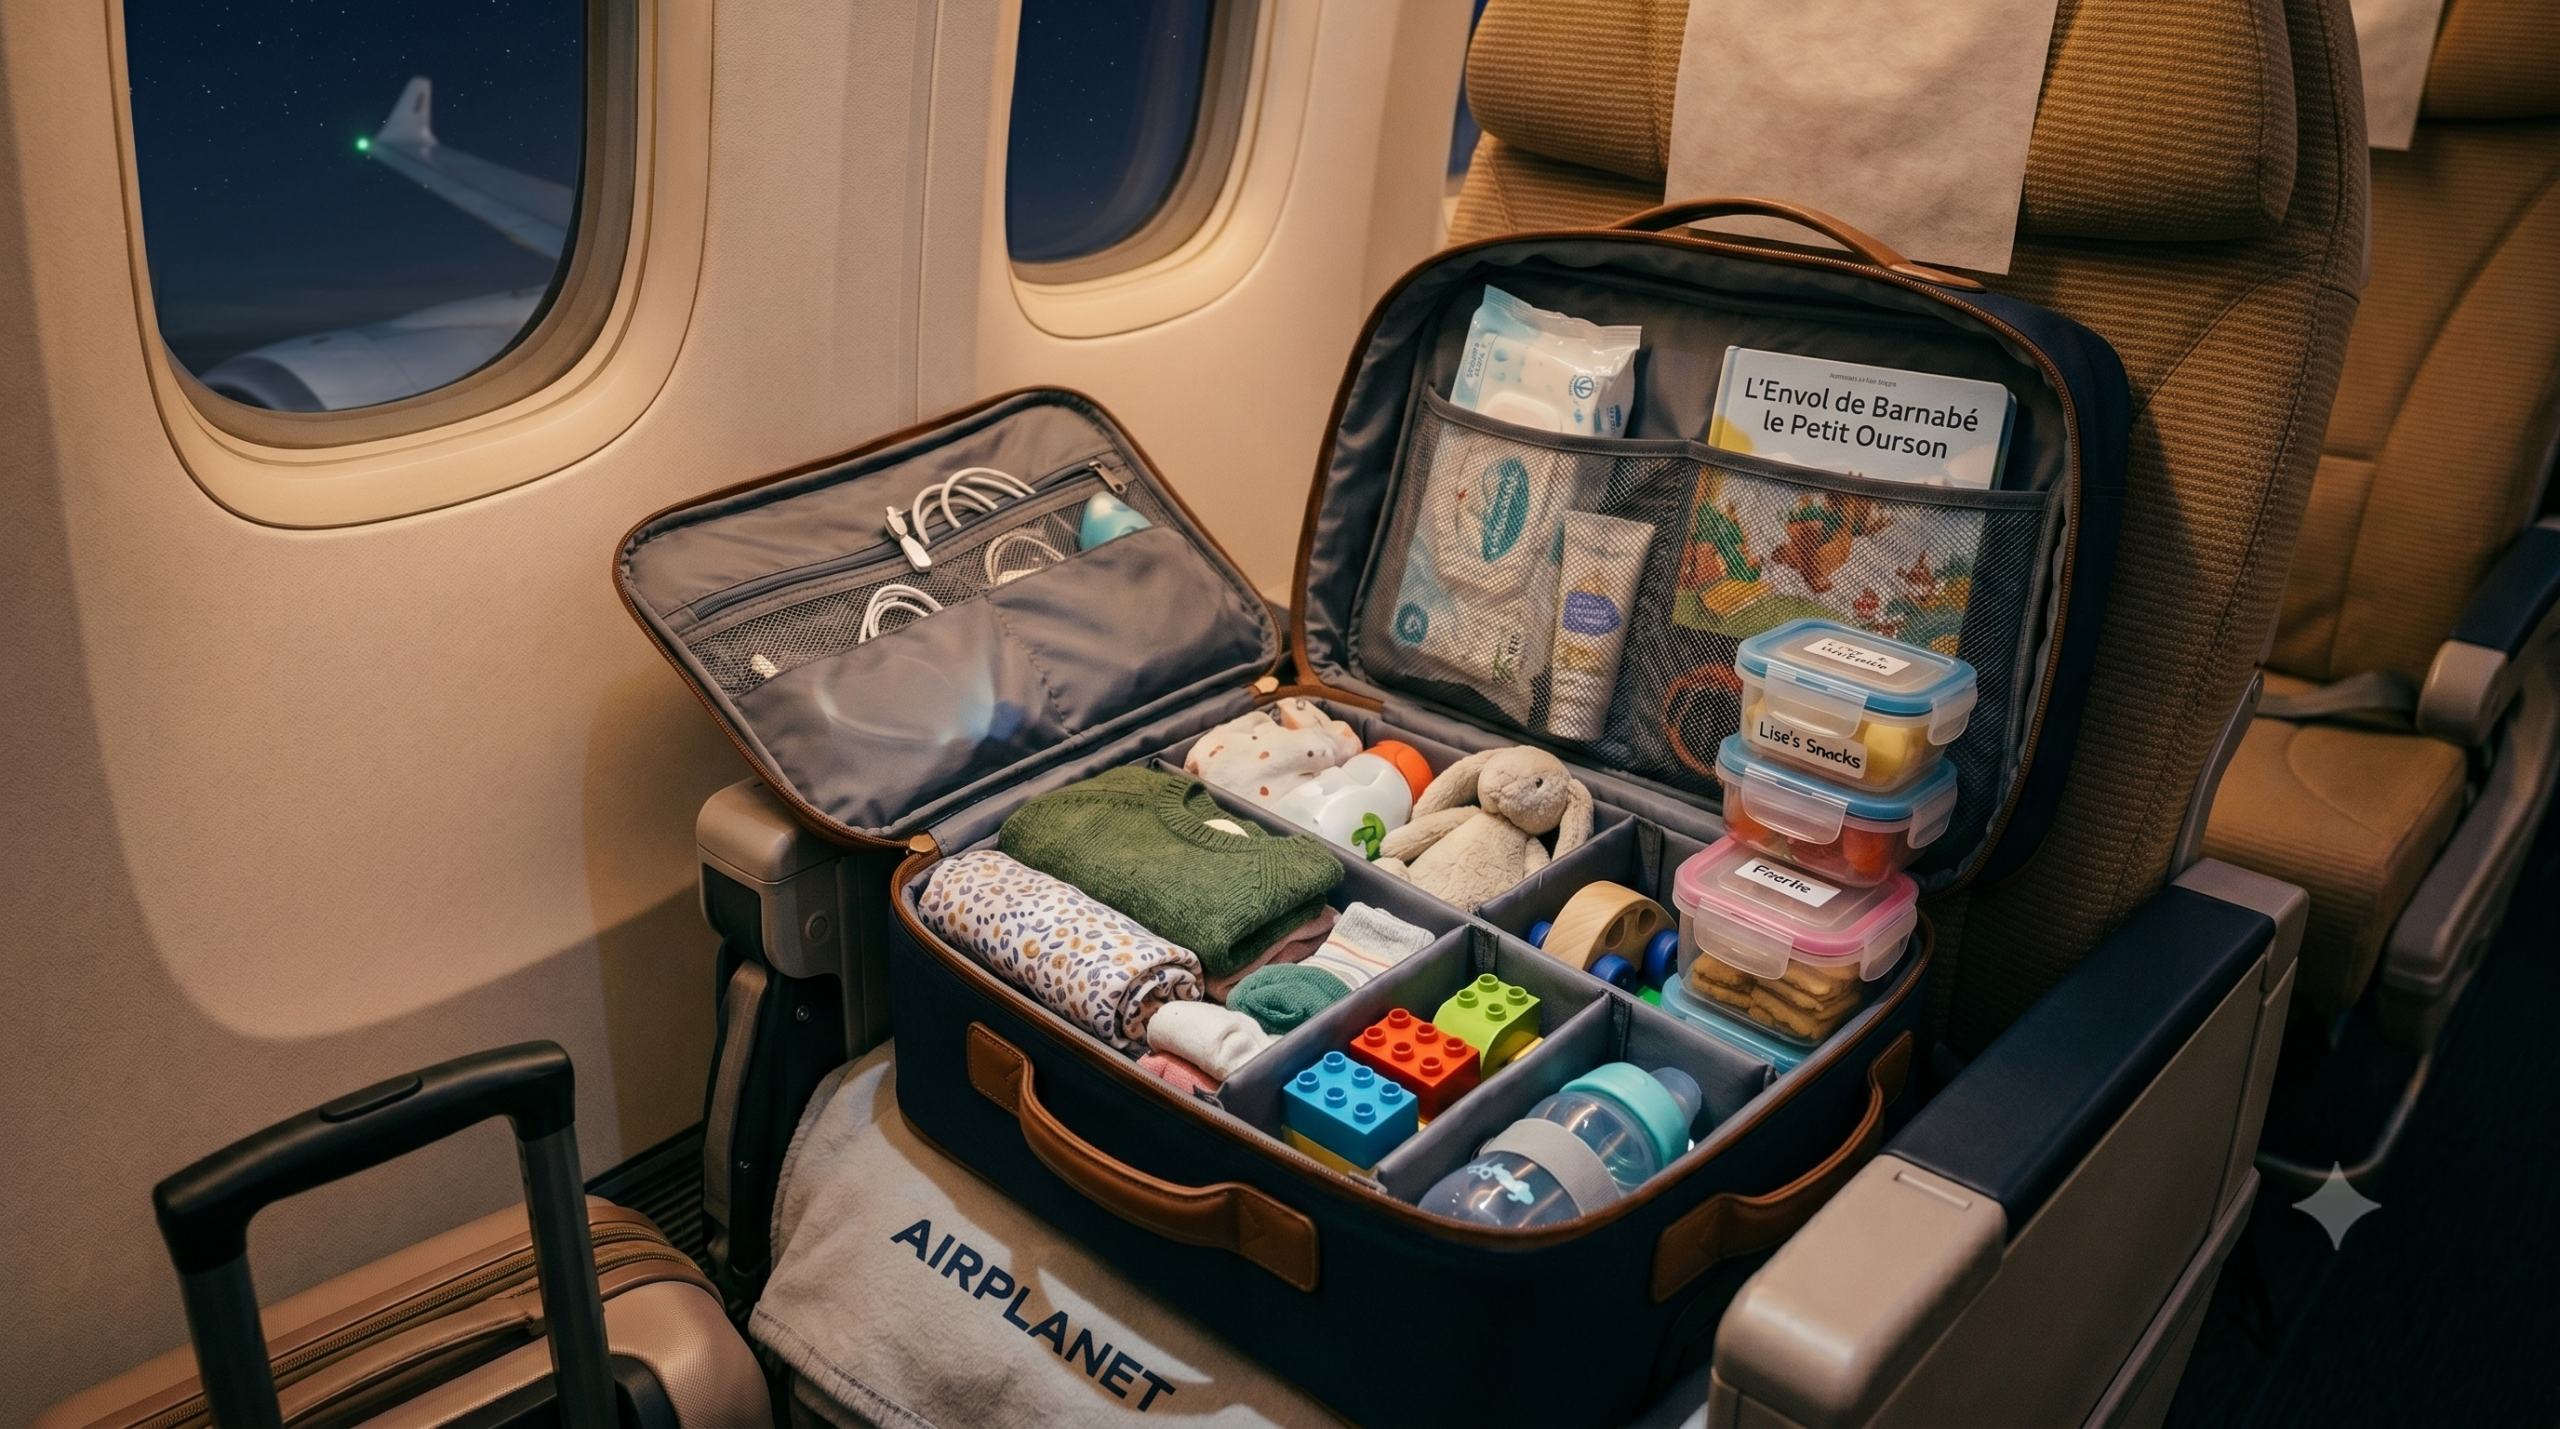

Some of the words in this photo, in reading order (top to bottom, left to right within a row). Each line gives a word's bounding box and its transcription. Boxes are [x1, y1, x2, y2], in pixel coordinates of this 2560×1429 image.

[1745, 377, 1828, 410] L'Envol
[1835, 391, 1866, 415] de
[1872, 396, 1979, 432] Barnabé
[1763, 410, 1784, 433] le
[1790, 415, 1850, 444] Petit
[1856, 425, 1948, 460] Ourson
[1759, 721, 1800, 748] Lise's
[1806, 738, 1861, 769] Snacks
[890, 1218, 1176, 1413] AIRPLANET
